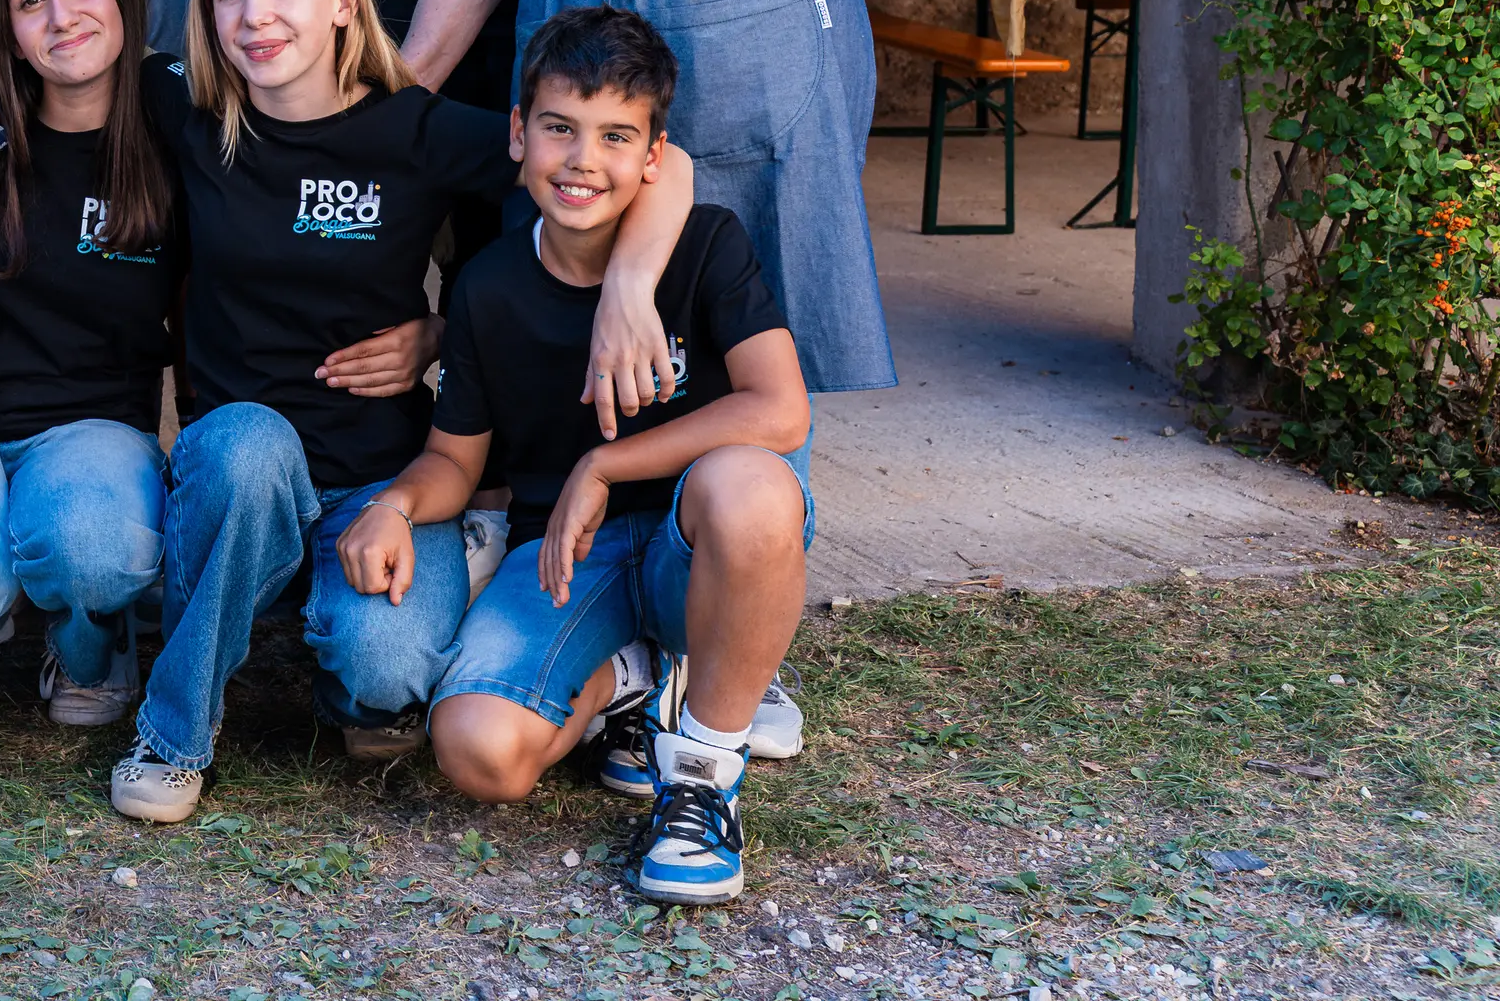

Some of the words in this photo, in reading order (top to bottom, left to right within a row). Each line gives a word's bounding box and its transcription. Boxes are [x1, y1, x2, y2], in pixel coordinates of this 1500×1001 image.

[300, 179, 359, 203] PRO
[297, 201, 379, 223] LOCO
[292, 214, 353, 239] Borgo
[334, 232, 376, 241] VALSUGANA
